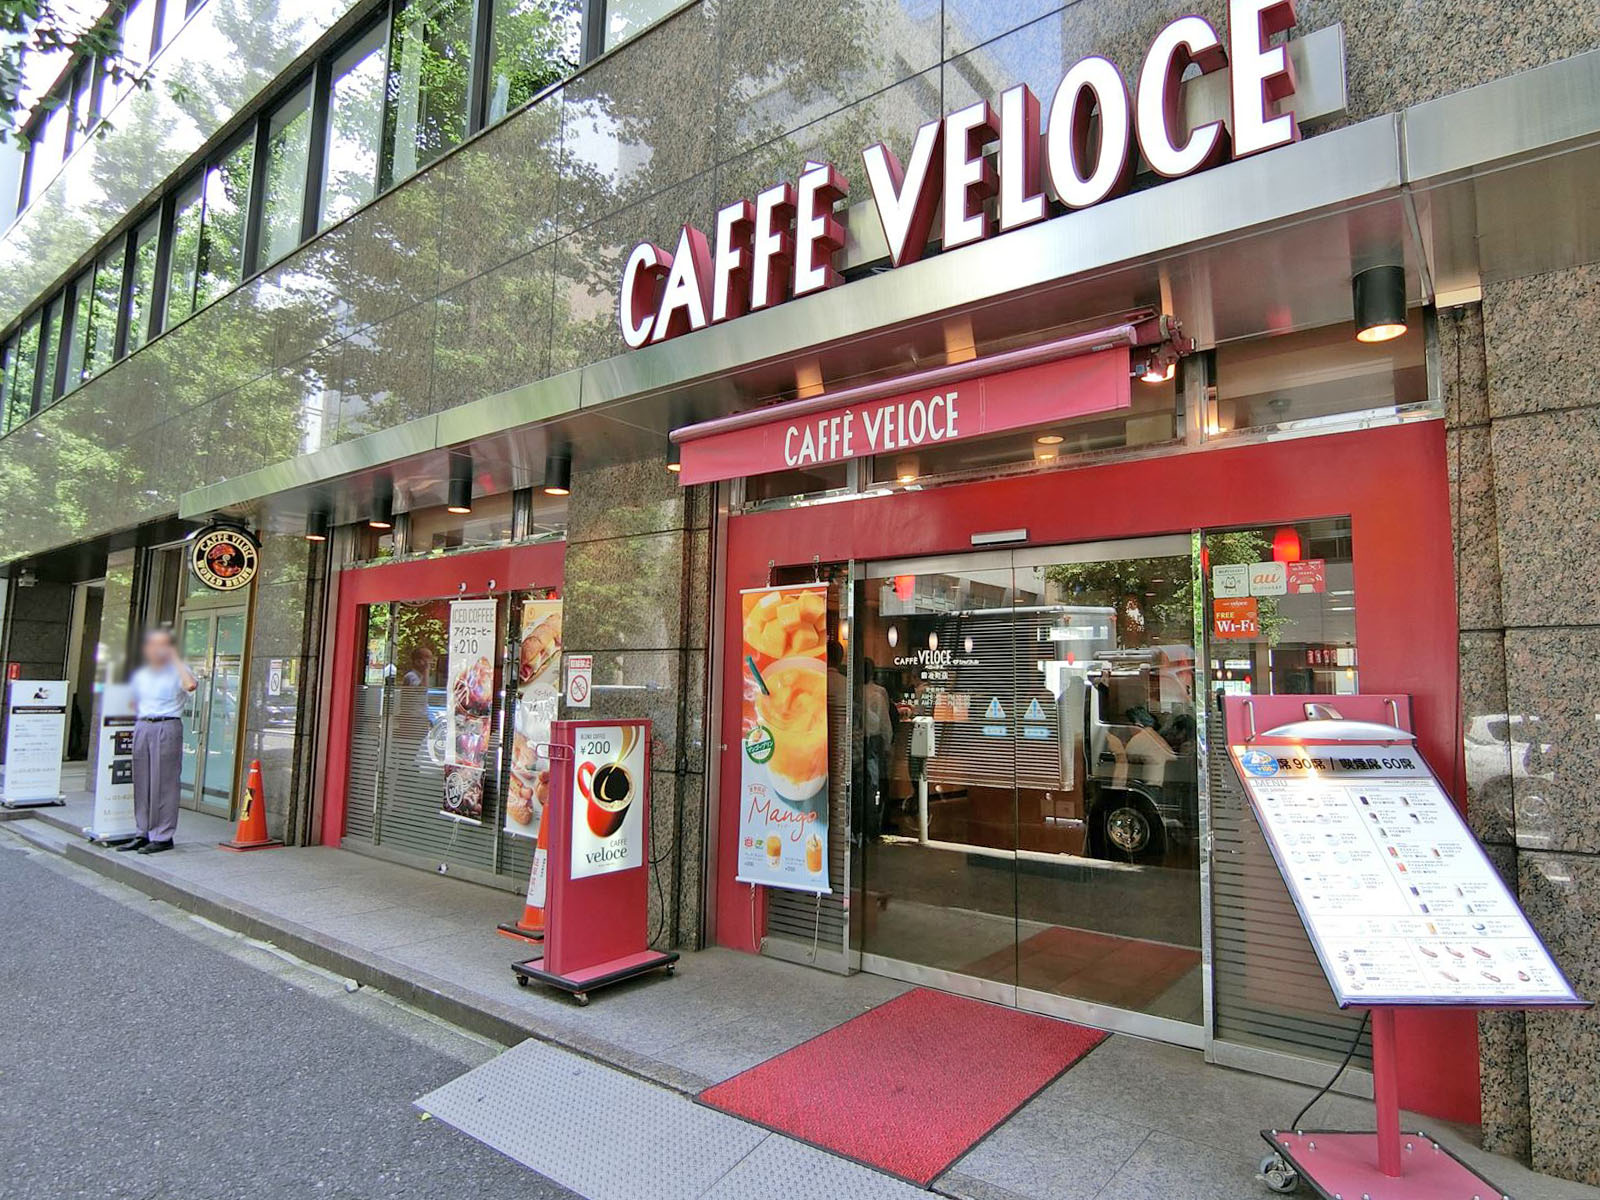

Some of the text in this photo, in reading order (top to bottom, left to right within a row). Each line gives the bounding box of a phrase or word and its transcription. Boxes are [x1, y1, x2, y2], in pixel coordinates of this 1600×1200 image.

[619, 0, 1300, 349] CAFFÈ VELOCE
[784, 391, 960, 467] CAFFÈ VELOCE
[197, 560, 253, 587] WORLD BEANS
[1253, 574, 1280, 584] au
[452, 608, 494, 623] ICED COFFEE
[454, 627, 491, 636] アイスコーヒー
[454, 640, 478, 654] ¥210
[918, 650, 951, 665] VELOCE
[580, 741, 611, 755] ¥200
[1254, 779, 1288, 787] MENU
[748, 797, 818, 842] Mango
[585, 847, 629, 865] veloce
